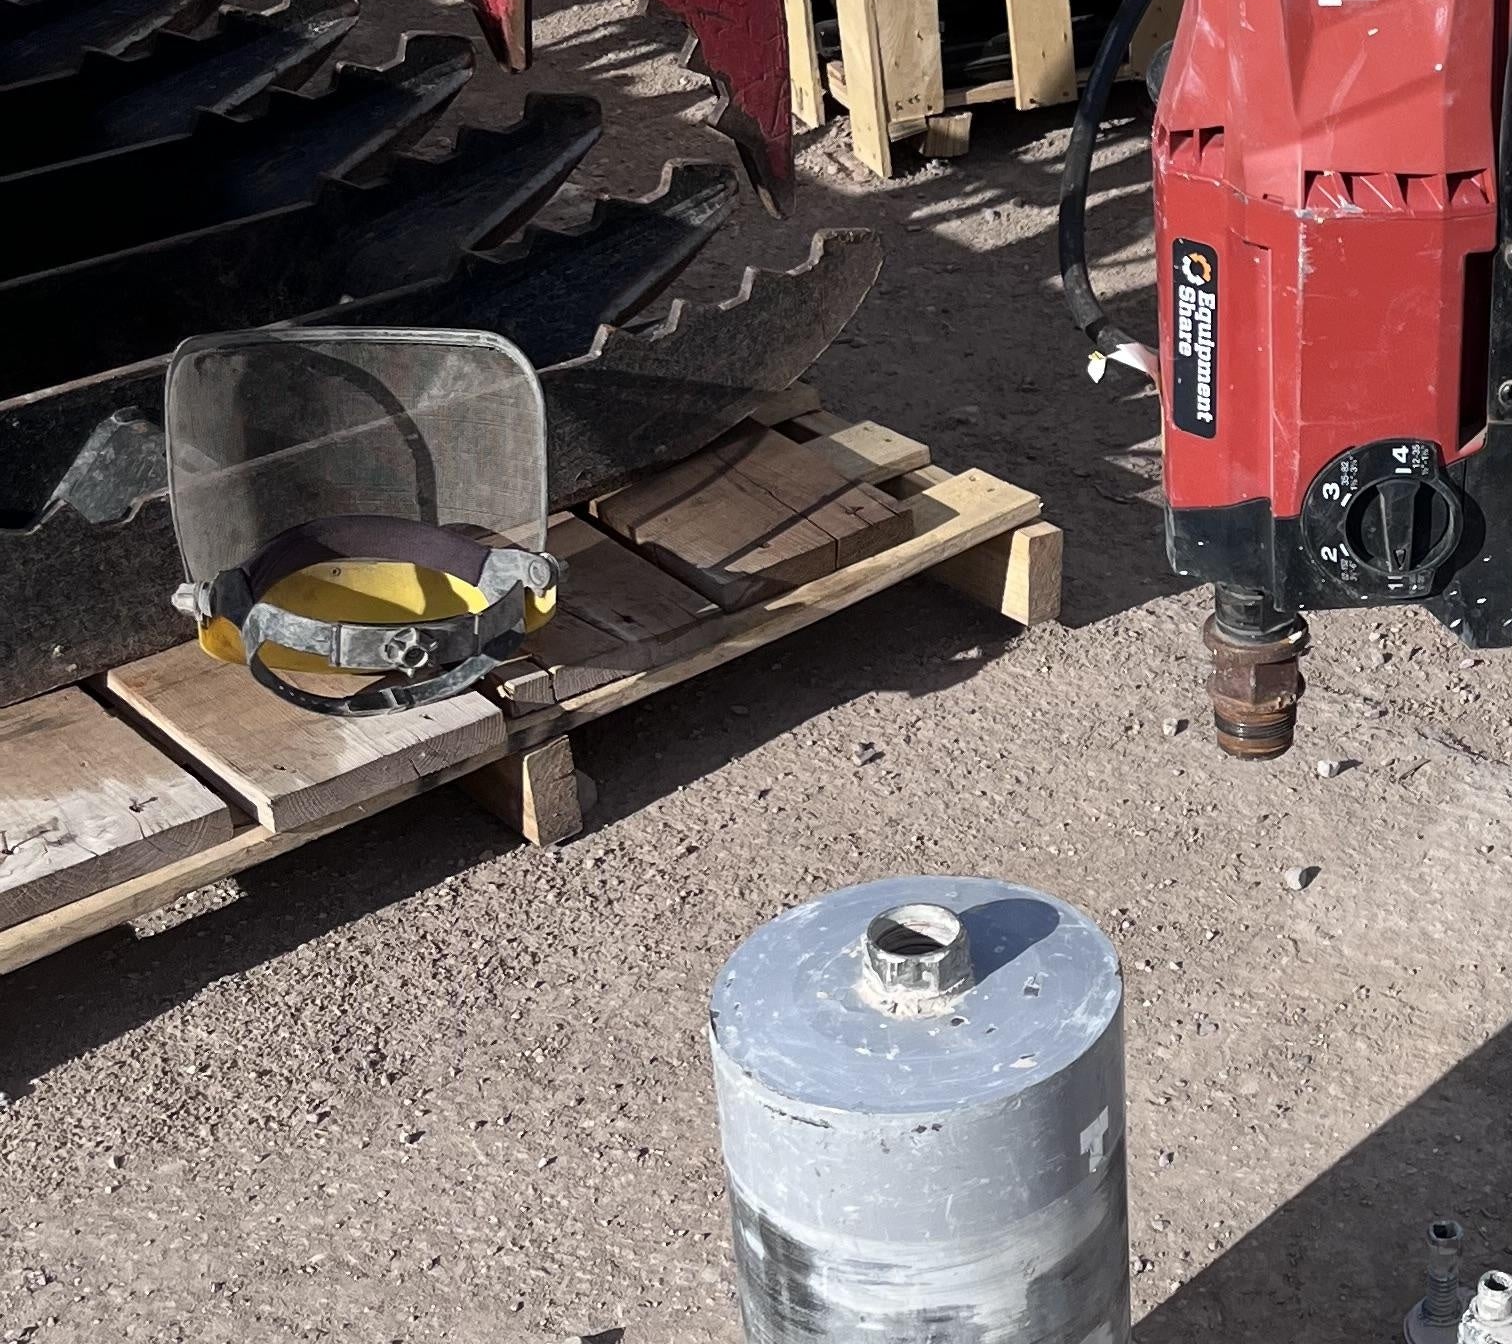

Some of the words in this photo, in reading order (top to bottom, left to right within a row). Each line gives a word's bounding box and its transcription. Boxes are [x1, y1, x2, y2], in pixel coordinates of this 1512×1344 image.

[1178, 286, 1194, 358] Share
[1195, 292, 1216, 423] Equipment
[1392, 445, 1409, 463] 4
[1322, 482, 1340, 500] 3
[1320, 546, 1337, 562] 2
